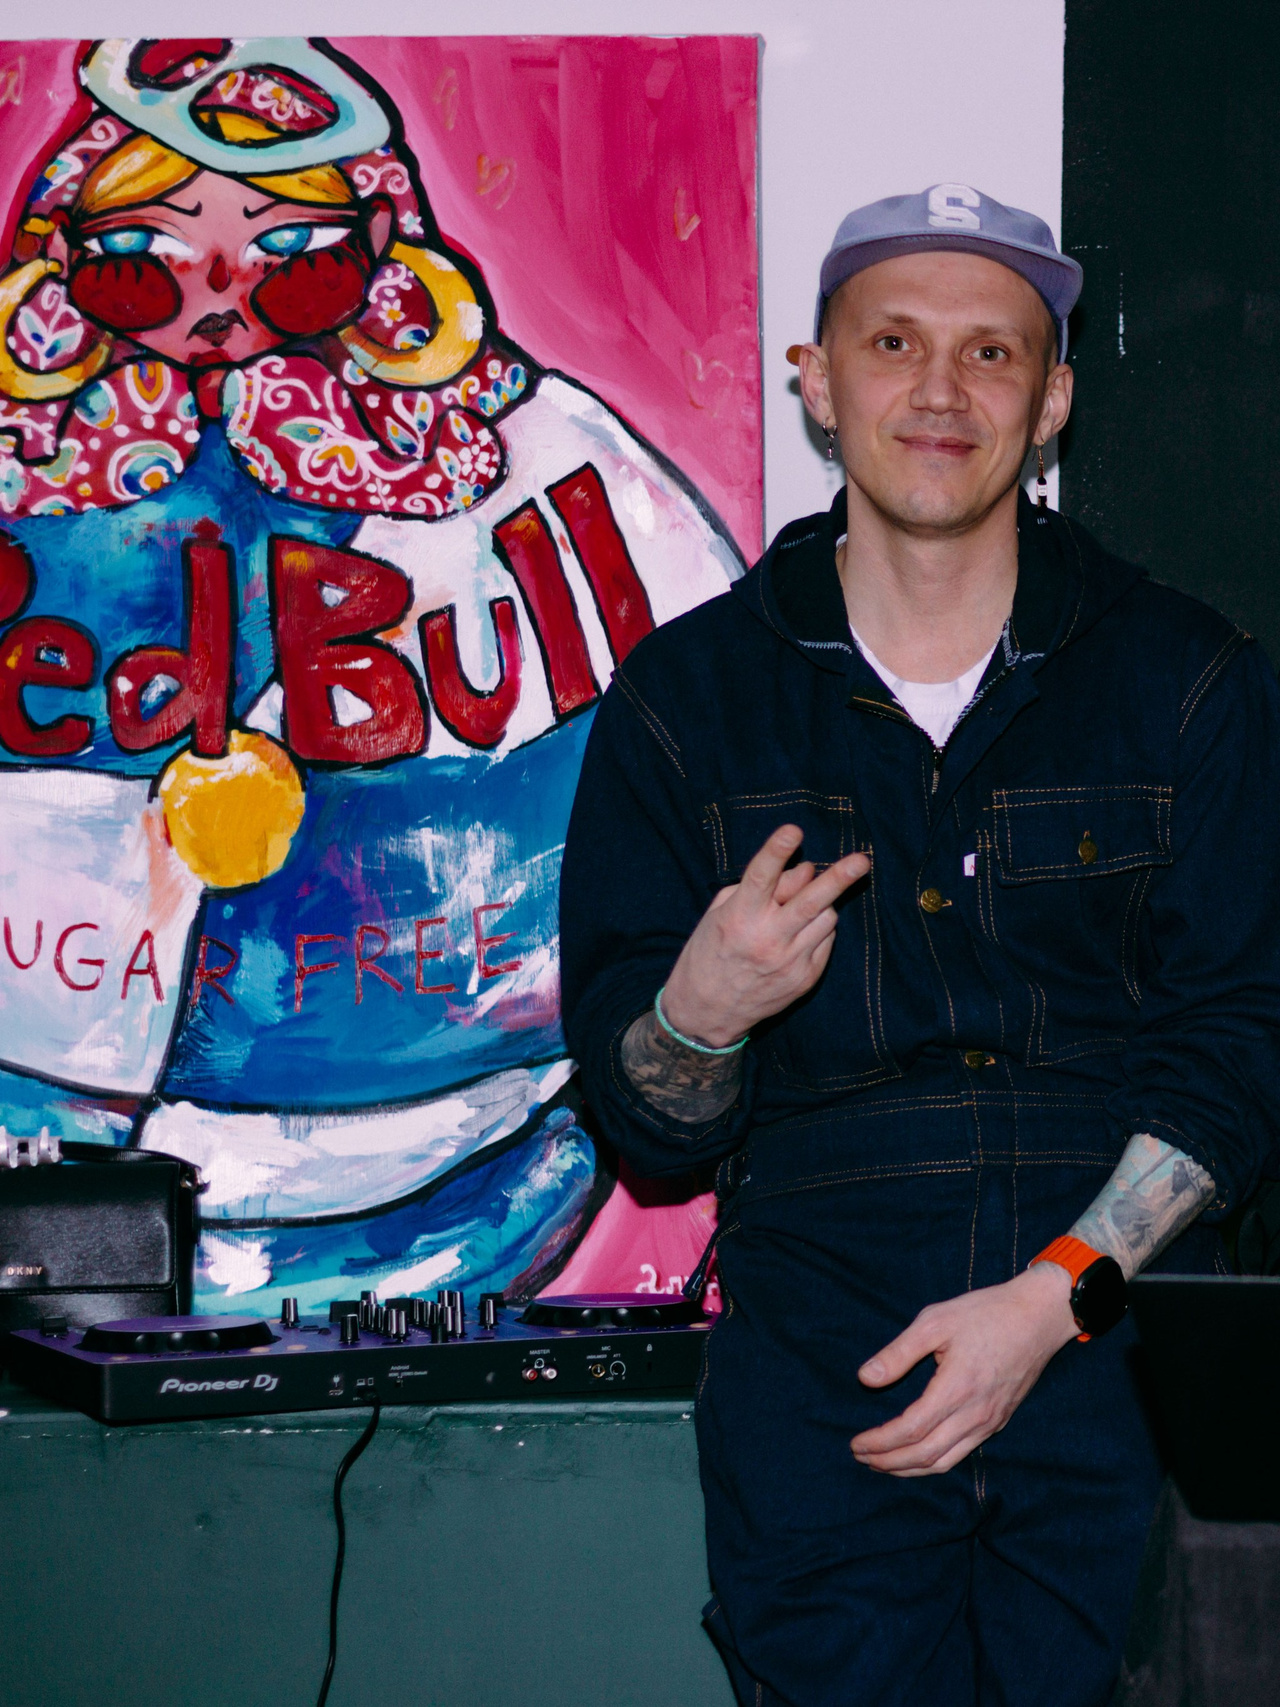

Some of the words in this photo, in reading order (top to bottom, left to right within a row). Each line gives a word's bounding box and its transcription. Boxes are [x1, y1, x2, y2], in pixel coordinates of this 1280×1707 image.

[928, 182, 981, 231] S
[268, 462, 655, 768] Bull
[294, 900, 524, 1013] FREE
[7, 1266, 43, 1276] DKNY
[160, 1378, 250, 1393] Pioneer
